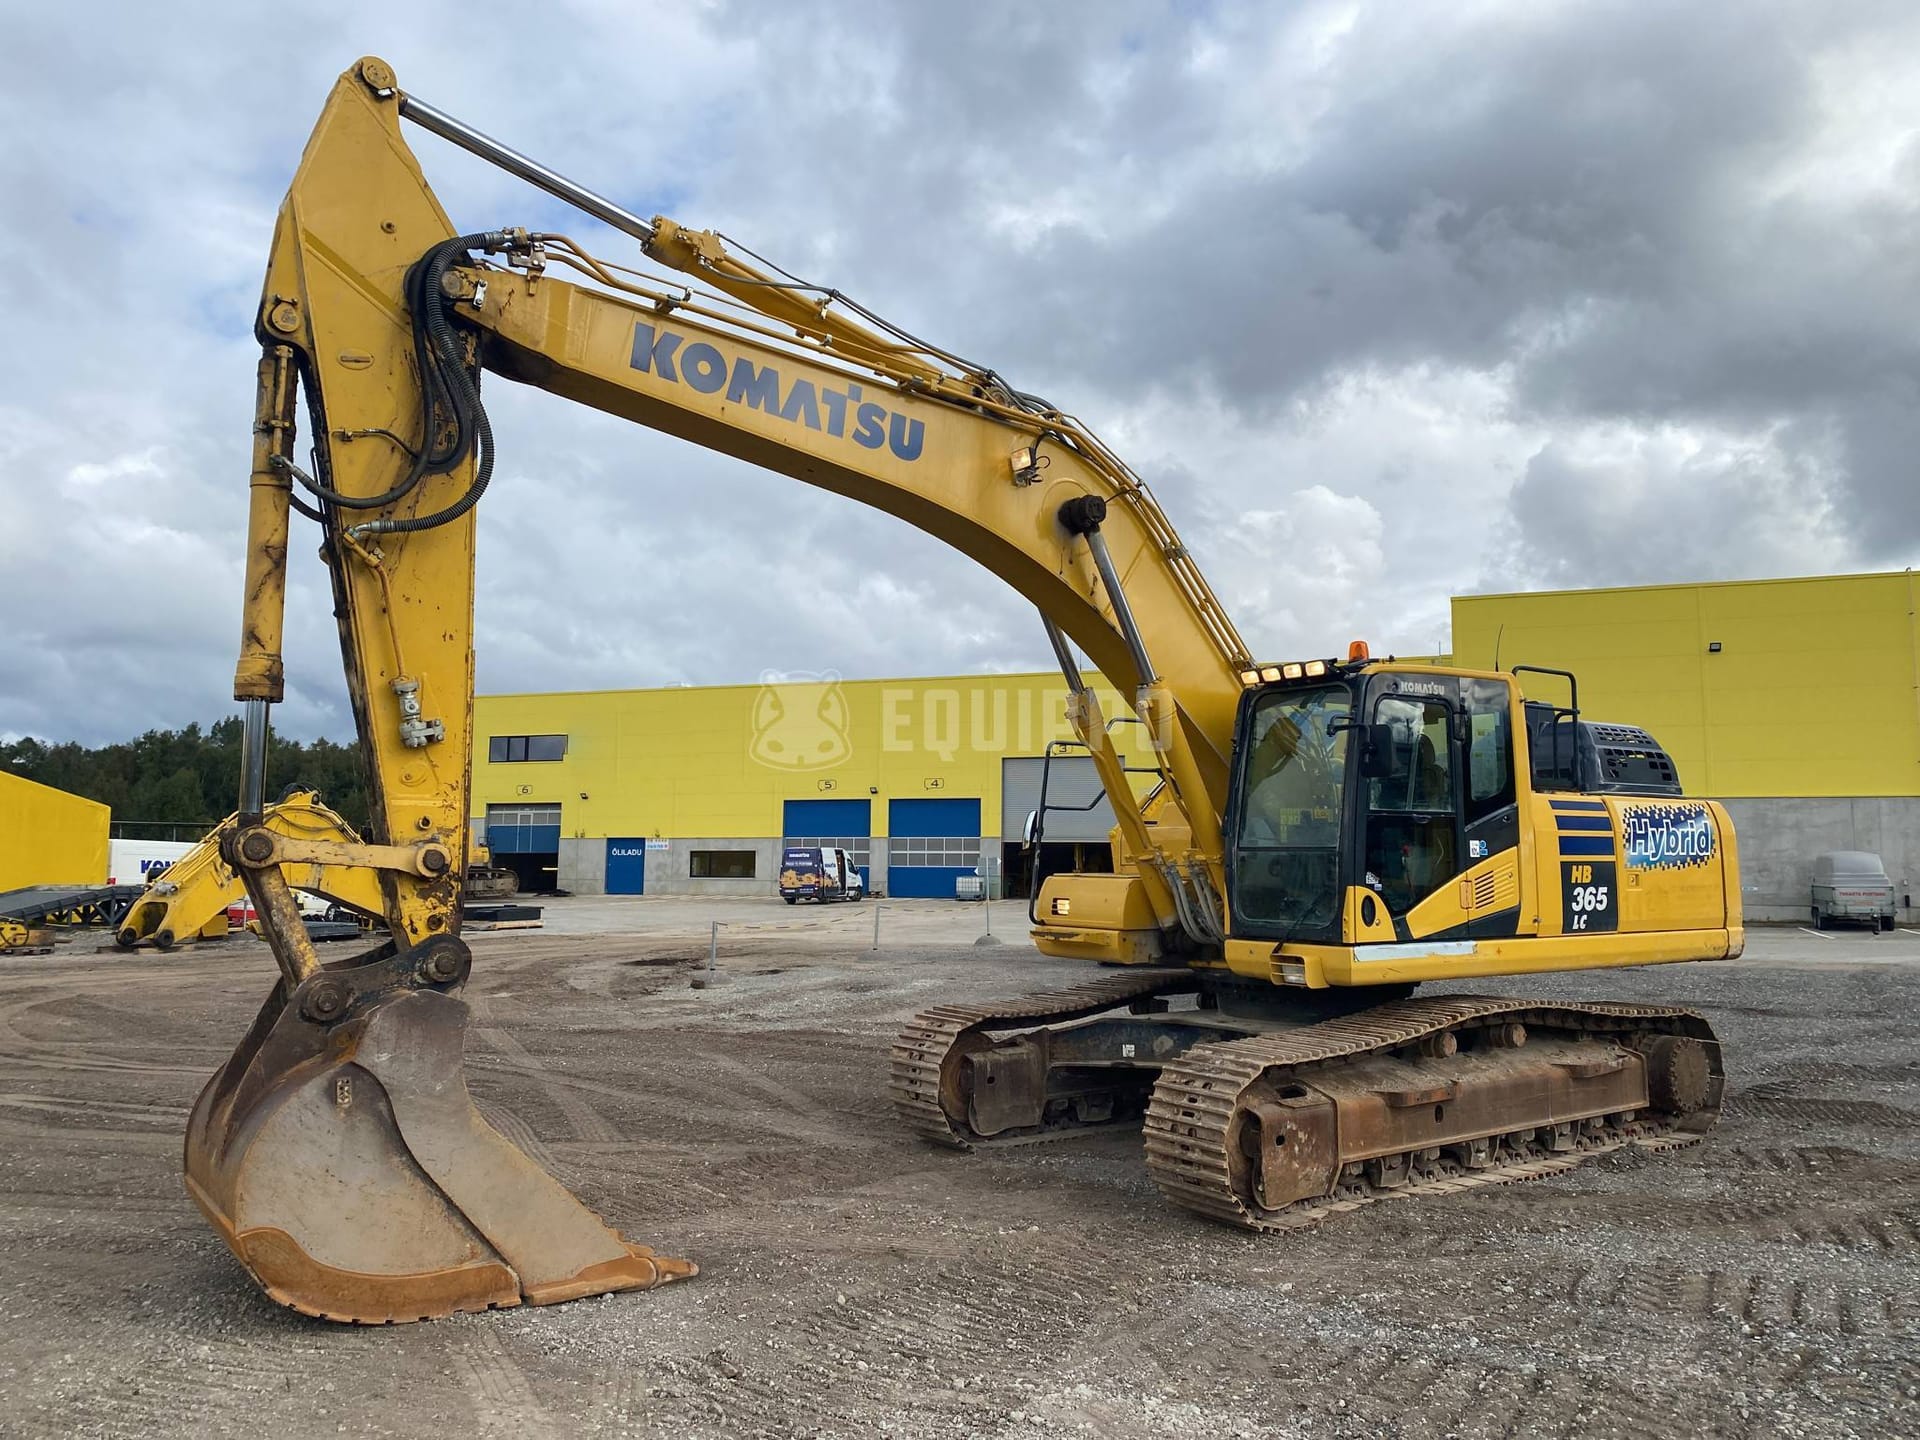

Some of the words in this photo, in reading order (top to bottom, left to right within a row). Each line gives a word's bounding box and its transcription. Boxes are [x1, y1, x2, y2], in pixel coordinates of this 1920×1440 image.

[630, 321, 926, 462] KOMATSU
[1400, 681, 1445, 696] KOMATSU
[521, 785, 529, 794] 6
[824, 781, 832, 789] 5
[930, 779, 939, 788] 4
[1630, 818, 1711, 861] Hybrid
[1571, 865, 1592, 884] HB
[1571, 886, 1608, 912] 365
[1572, 914, 1587, 930] LC
